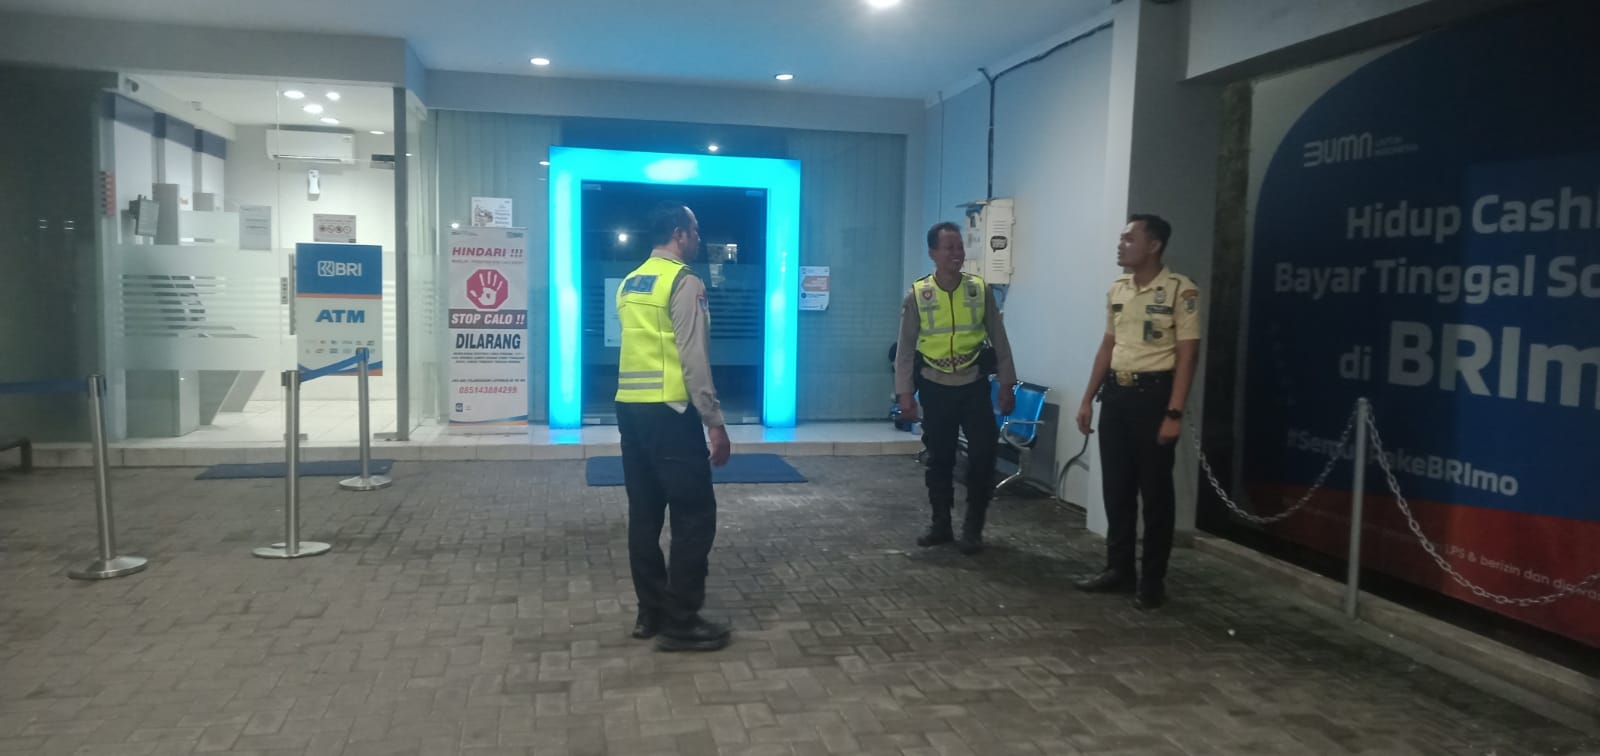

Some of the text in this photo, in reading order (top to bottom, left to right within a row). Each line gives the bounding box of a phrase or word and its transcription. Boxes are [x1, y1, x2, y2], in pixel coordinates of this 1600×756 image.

[1347, 200, 1461, 244] Hidup
[452, 247, 524, 258] HINDARI !!!
[334, 262, 362, 276] BRI
[1274, 262, 1366, 299] Bayar
[1374, 254, 1536, 305] Tinggal
[315, 309, 365, 323] ATM
[451, 313, 525, 325] STOP CALO !!
[455, 333, 521, 350] DILARANG
[1339, 346, 1371, 380] di
[1467, 551, 1477, 563] &
[1480, 554, 1521, 576] berizin
[1524, 569, 1549, 585] dan
